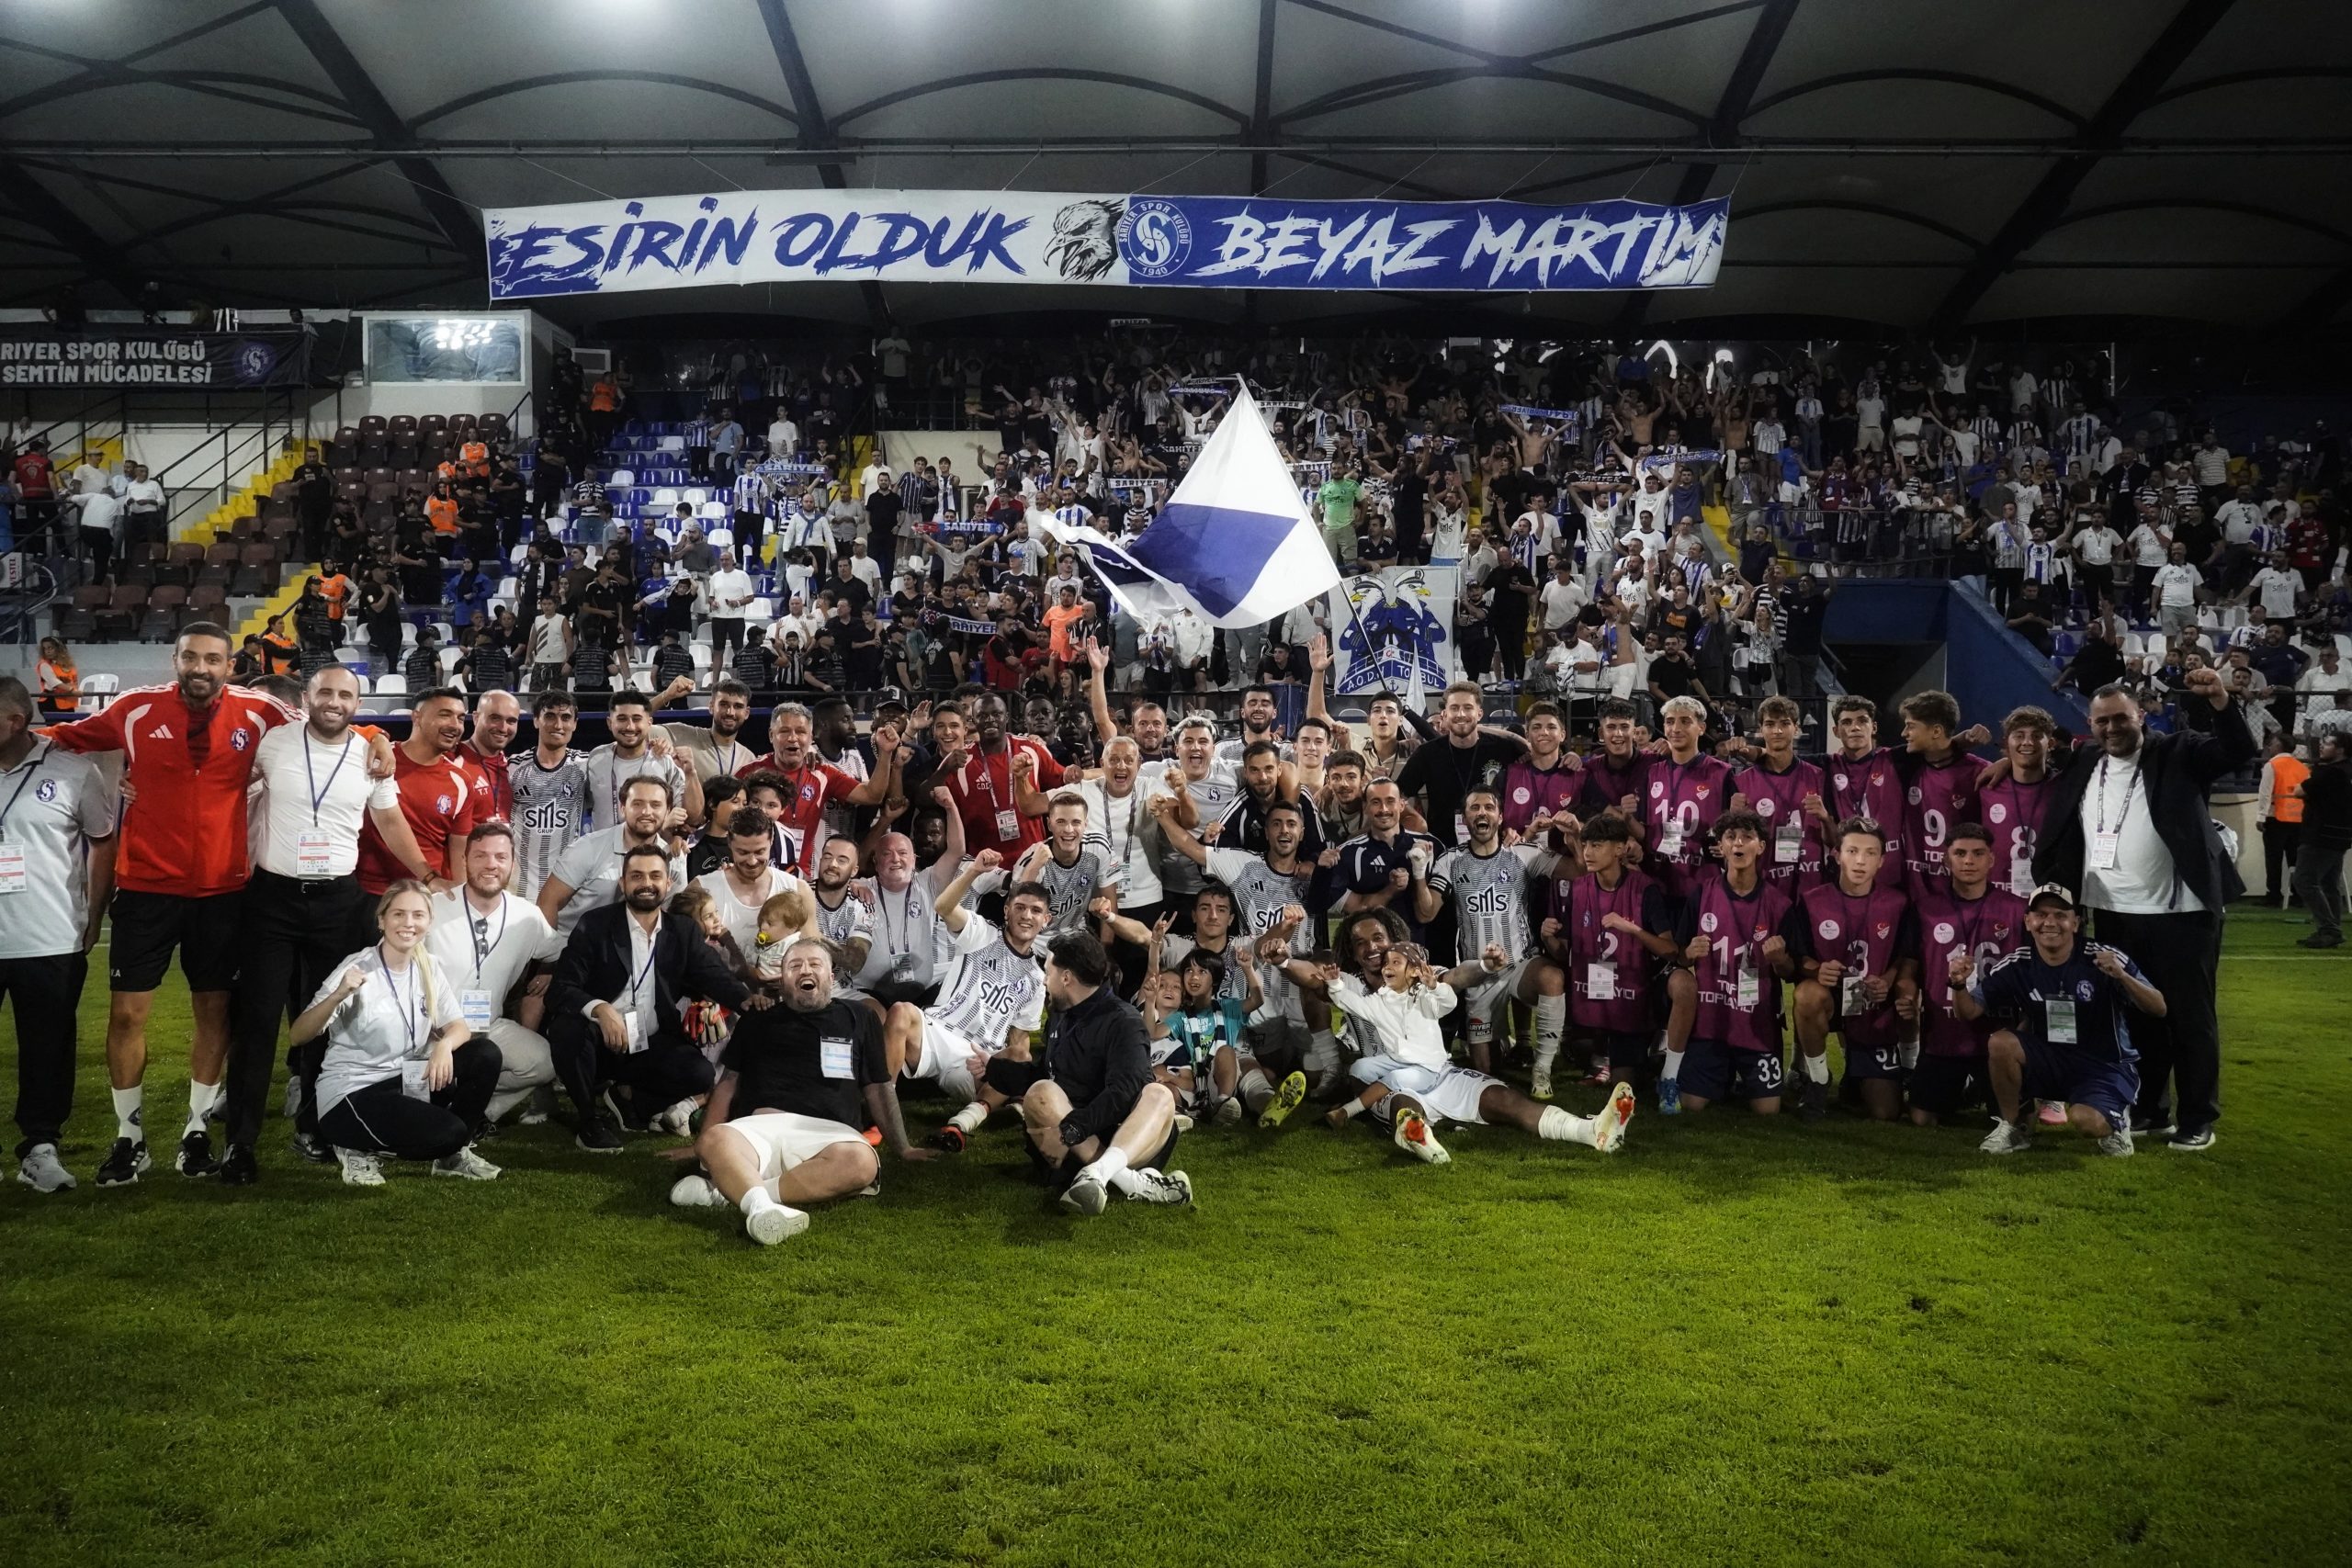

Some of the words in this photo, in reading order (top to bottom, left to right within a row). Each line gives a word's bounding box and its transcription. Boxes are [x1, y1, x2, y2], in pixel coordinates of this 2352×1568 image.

[504, 196, 759, 276] ESİRİN
[772, 205, 1035, 276] OLDUK
[1119, 210, 1138, 243] SARIYER
[1140, 202, 1171, 214] SPOR
[1187, 204, 1456, 287] BEYAZ
[1461, 207, 1725, 288] MARTIM
[1141, 266, 1169, 276] 1940
[1, 342, 62, 360] RIYER
[66, 342, 120, 360] SPOR
[125, 340, 206, 361] KULÜBÜ
[3, 361, 80, 383] SEMTİN
[84, 359, 212, 384] MÜCADELESİ
[944, 522, 991, 532] SARIYER
[952, 621, 998, 634] ARIYER
[525, 798, 567, 829] SMS
[1655, 799, 1700, 838] 10
[1924, 809, 1946, 847] 9
[1467, 886, 1507, 913] SMS
[1255, 906, 1284, 929] SM
[980, 981, 1013, 1015] SMS
[1758, 1056, 1781, 1082] 33
